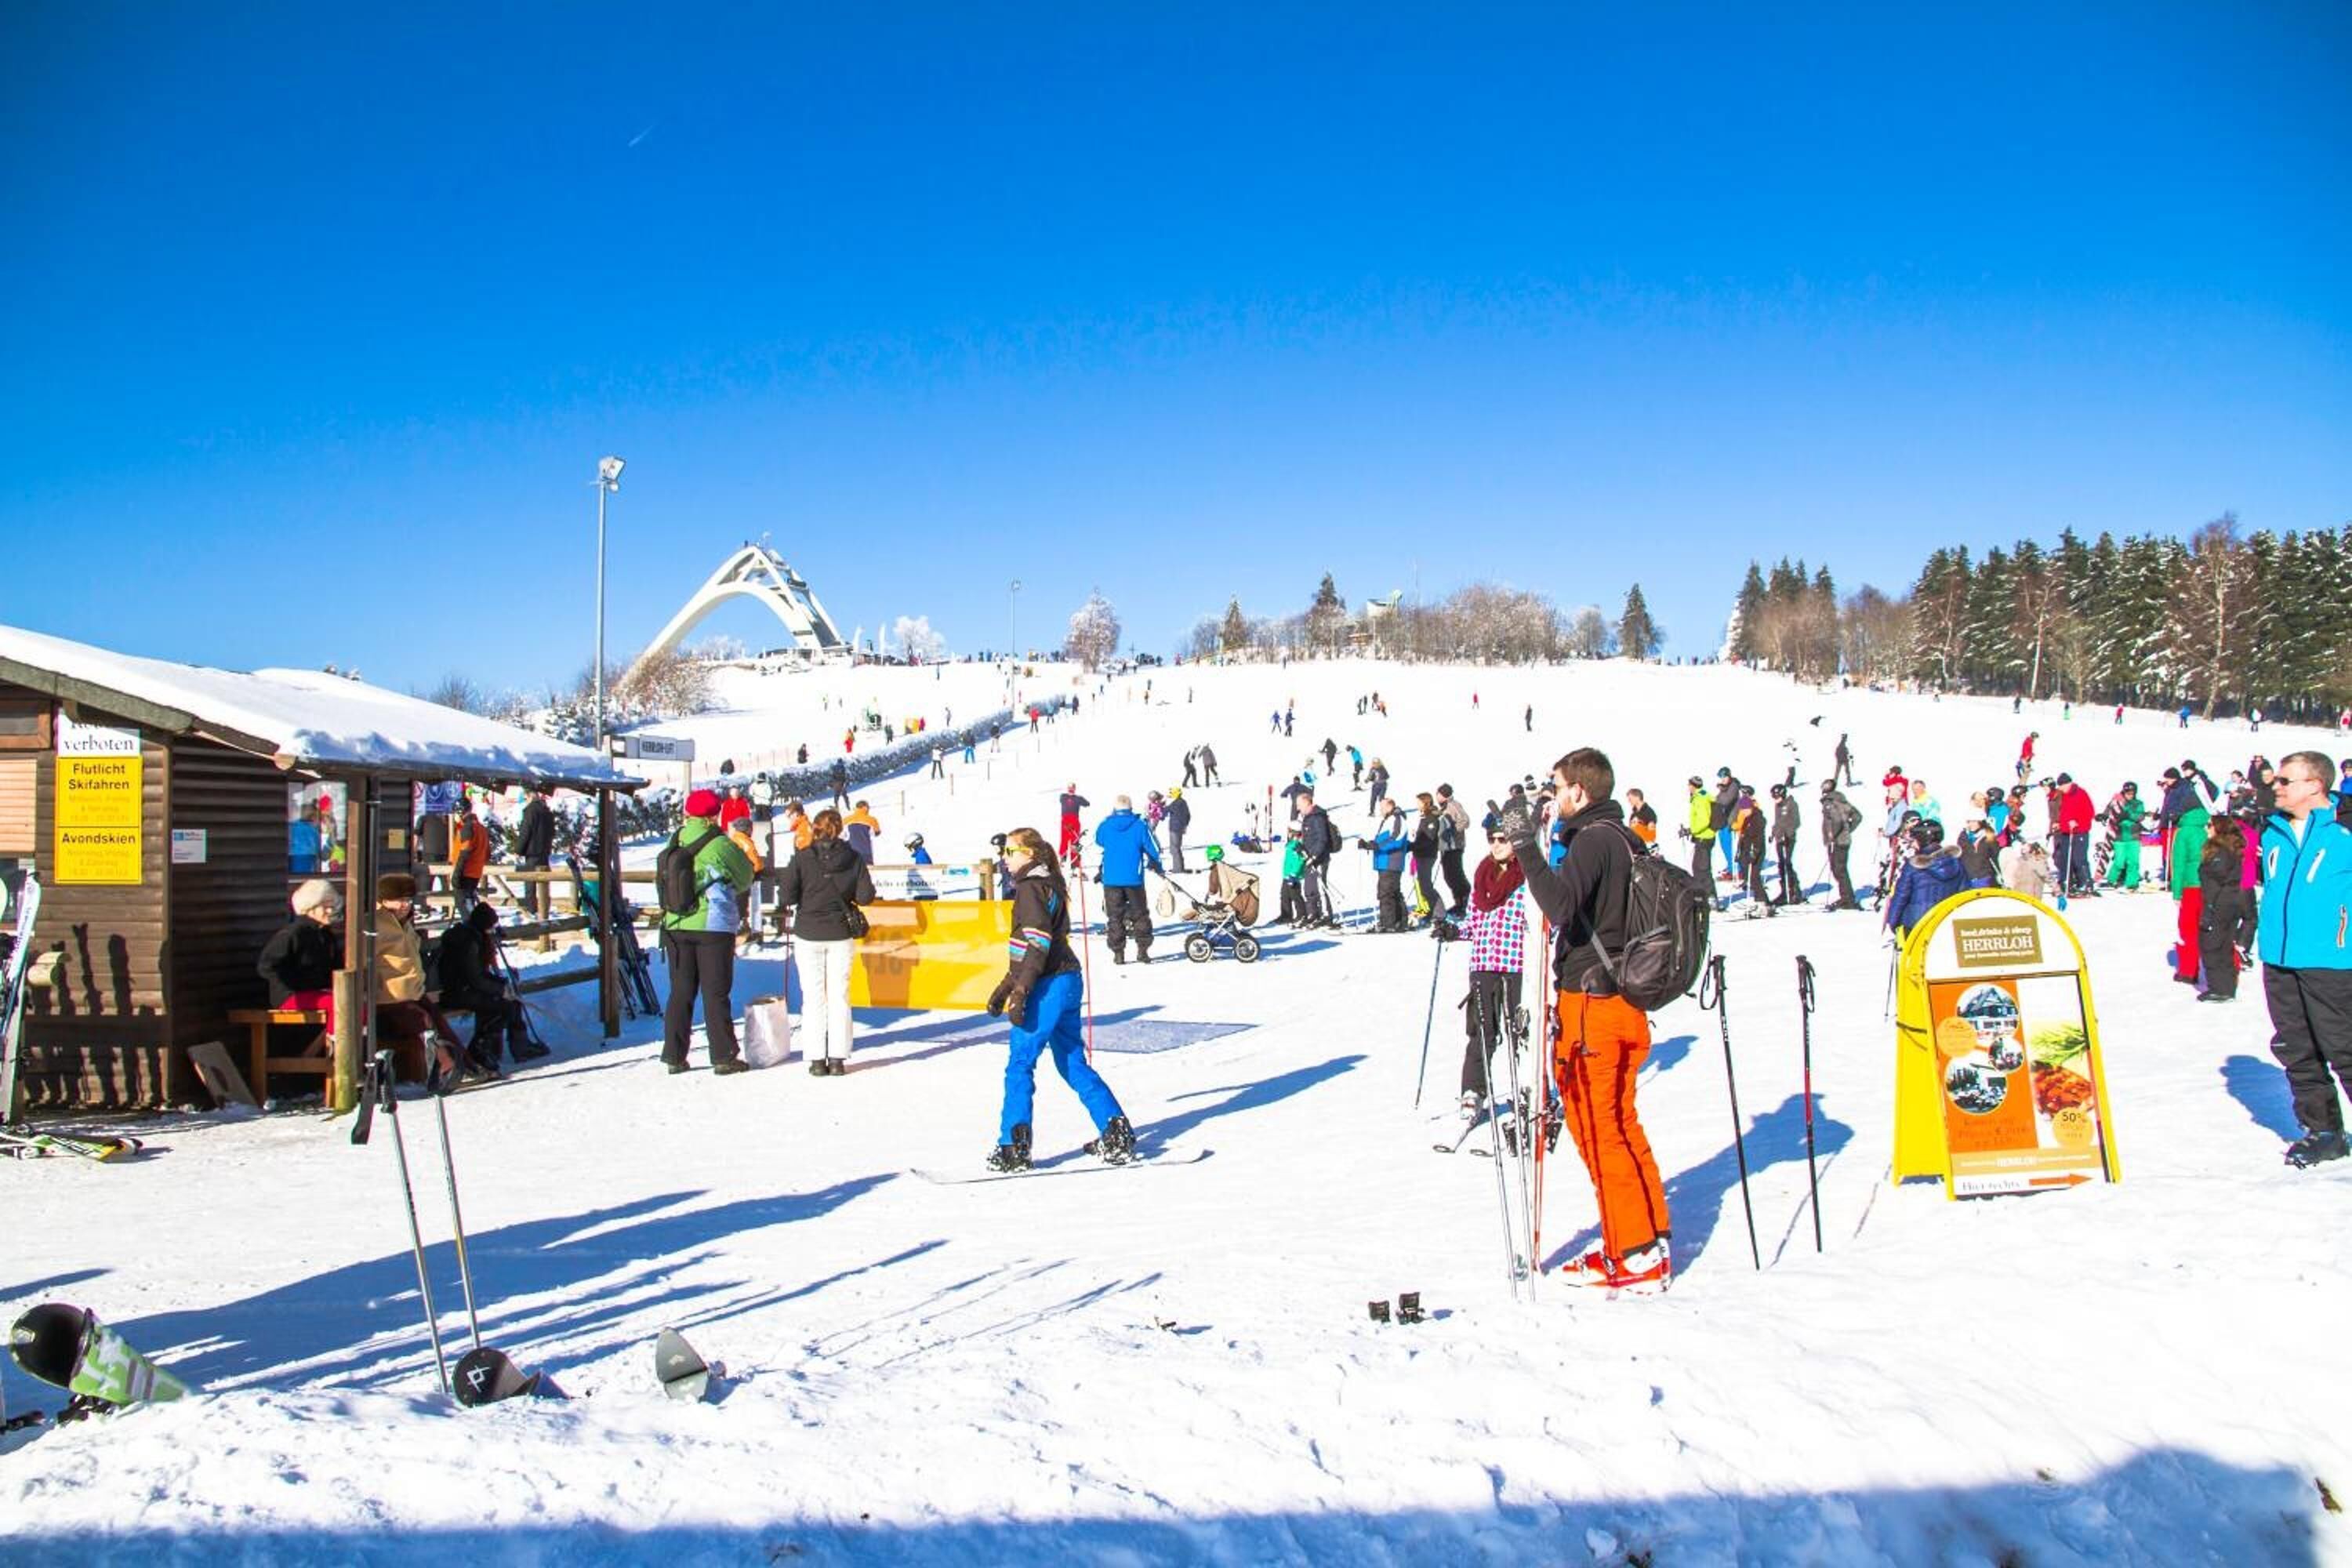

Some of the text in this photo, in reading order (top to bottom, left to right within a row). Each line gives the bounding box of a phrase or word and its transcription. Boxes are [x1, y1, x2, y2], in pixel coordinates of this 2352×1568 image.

[64, 735, 133, 750] verboten
[73, 763, 125, 775] Flutlicht
[68, 779, 129, 789] Skifahren
[62, 833, 136, 844] Avondskien
[1962, 936, 2033, 953] HERRLOH
